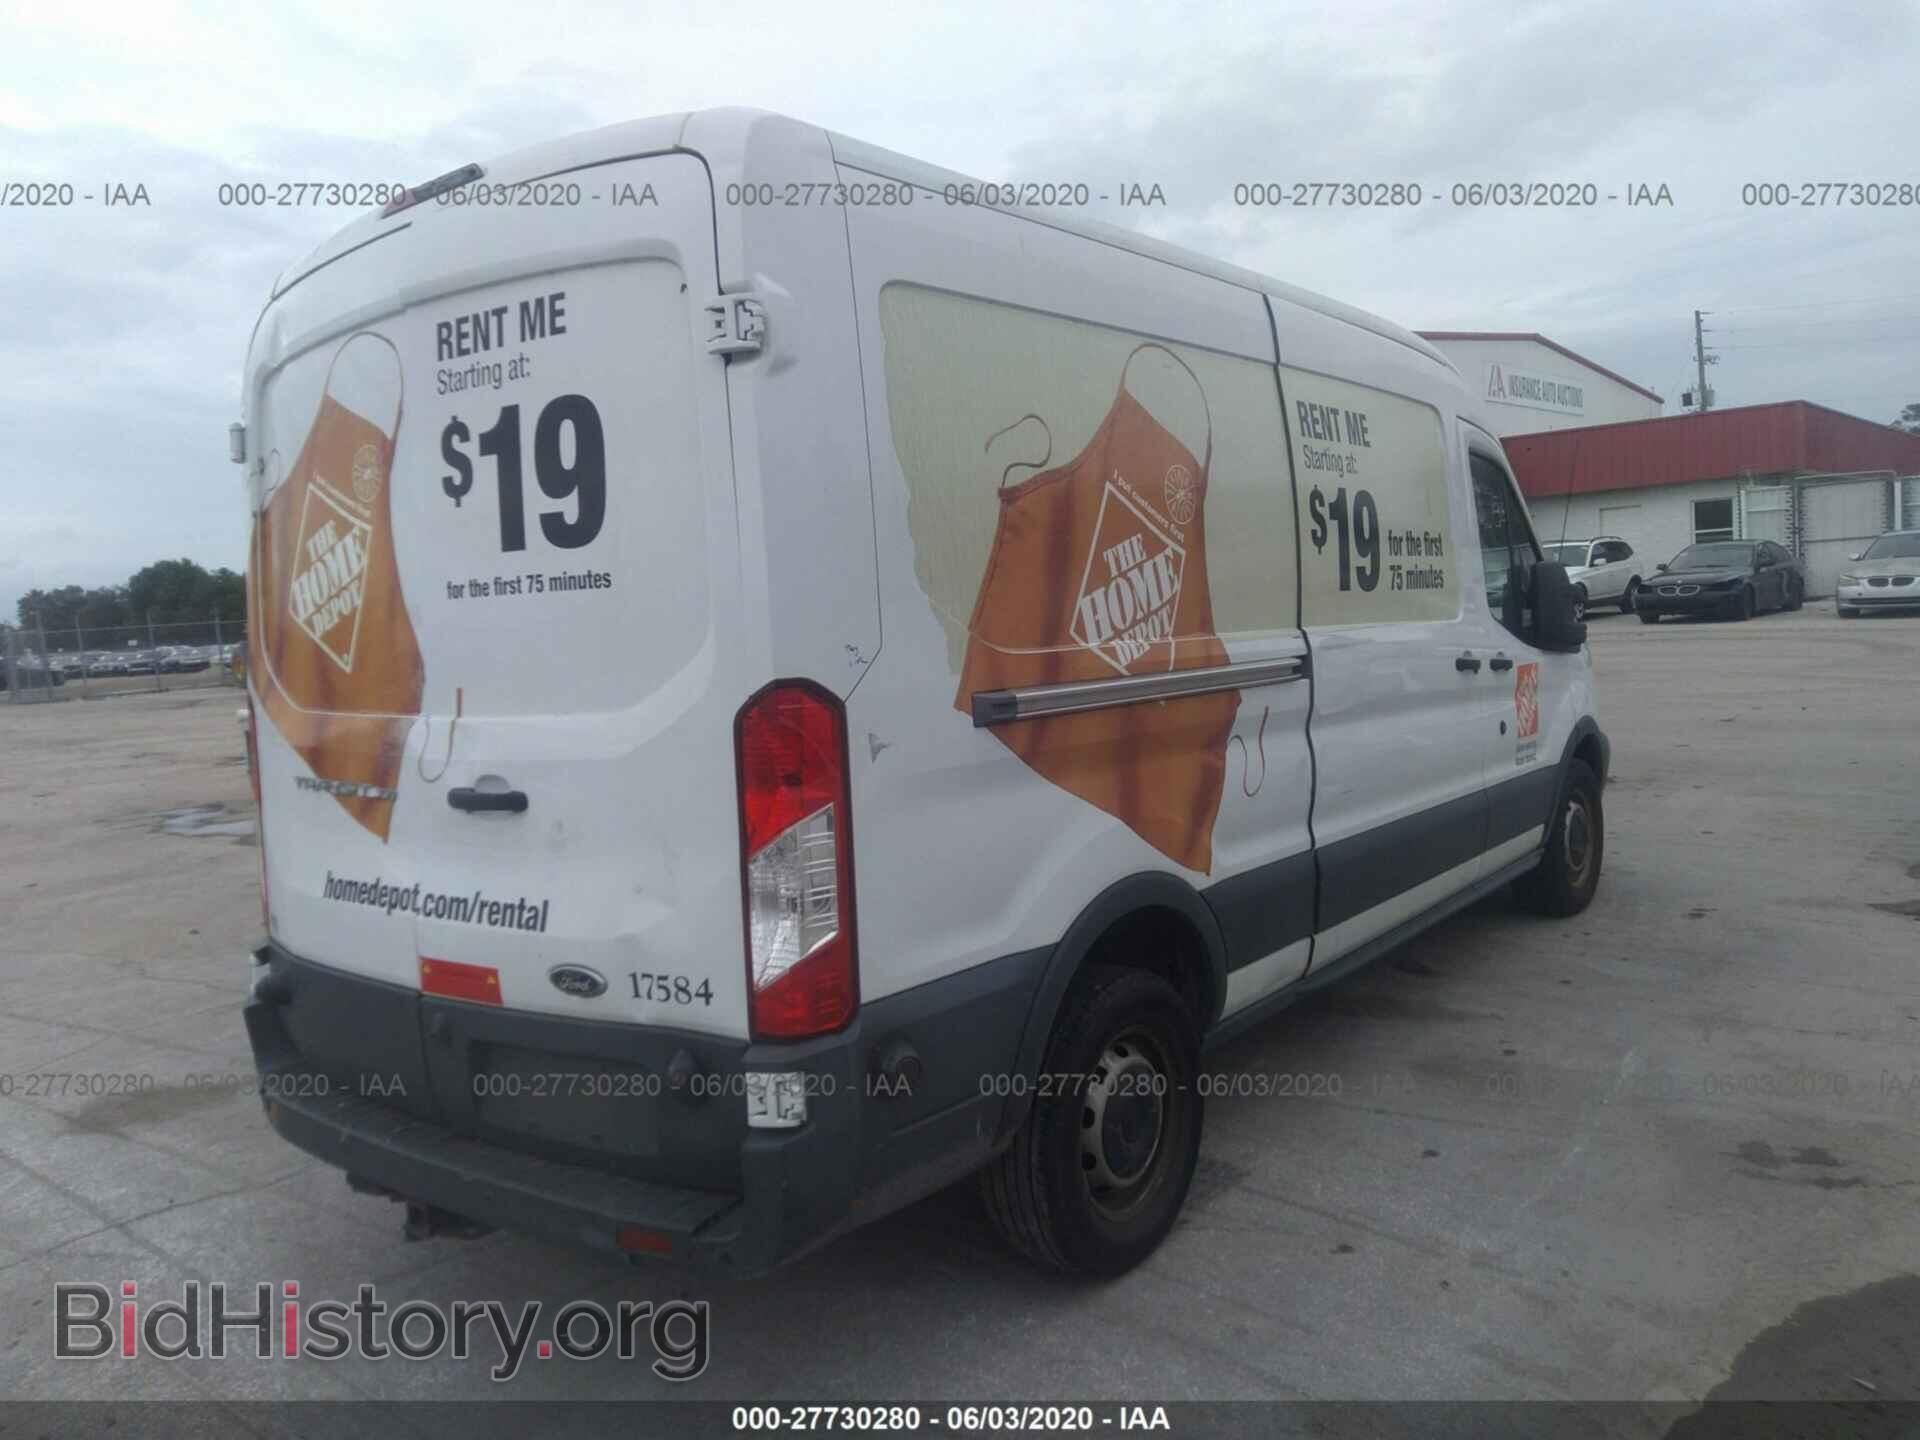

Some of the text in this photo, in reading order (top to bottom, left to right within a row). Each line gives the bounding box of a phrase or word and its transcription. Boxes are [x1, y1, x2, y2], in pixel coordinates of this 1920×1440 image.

[436, 292, 567, 361] RENT ME
[436, 352, 531, 396] Starting at:
[1296, 400, 1371, 448] RENT ME
[440, 394, 607, 553] $19
[1303, 444, 1344, 478] Starting
[1103, 533, 1147, 577] THE
[1309, 484, 1381, 592] $19
[1388, 529, 1443, 557] for the first
[292, 525, 368, 624] HOME
[446, 569, 612, 600] for the first 75 minutes
[1080, 544, 1180, 646] HOME
[1389, 564, 1444, 591] 75 minutes
[322, 870, 549, 933] homedepot.com/rental
[628, 971, 714, 1007] 17584
